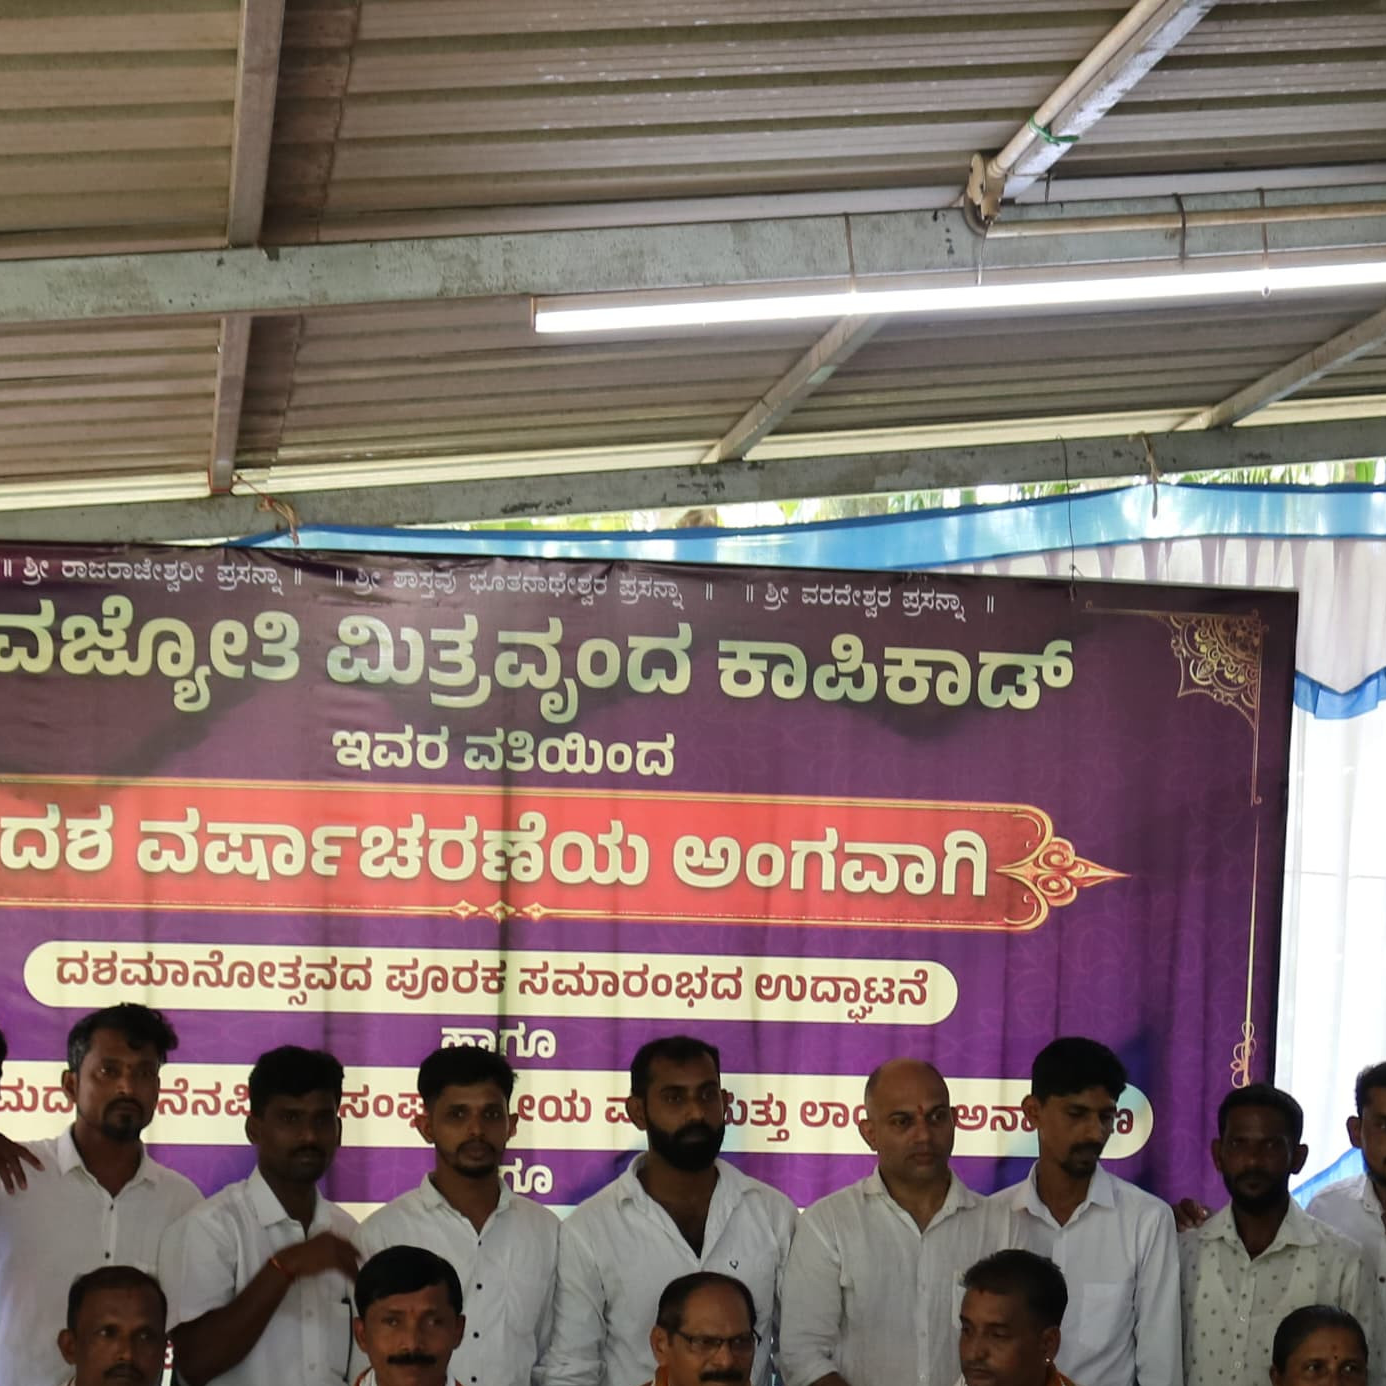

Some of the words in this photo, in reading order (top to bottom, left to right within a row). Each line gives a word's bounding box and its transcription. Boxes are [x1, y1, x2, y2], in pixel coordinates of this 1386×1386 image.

[327, 611, 692, 723] ಮಿತ್ರವೃಂದ
[717, 633, 1074, 712] ಕಾಪಿಕಾಡ್
[332, 724, 450, 772] ಇವರ
[464, 726, 675, 777] ವತಿಯಿಂದ
[0, 803, 114, 873] ದಶ
[137, 808, 650, 888] ವರ್ಷಾಚರಣೆಯ
[674, 828, 989, 896] ಅಂಗವಾಗಿ
[56, 948, 373, 1006] ದಶಮಾನೋತ್ಸವದ
[386, 957, 507, 1001] ಪೂರಕ
[519, 960, 743, 1008] ಸಮಾರಂಭದ
